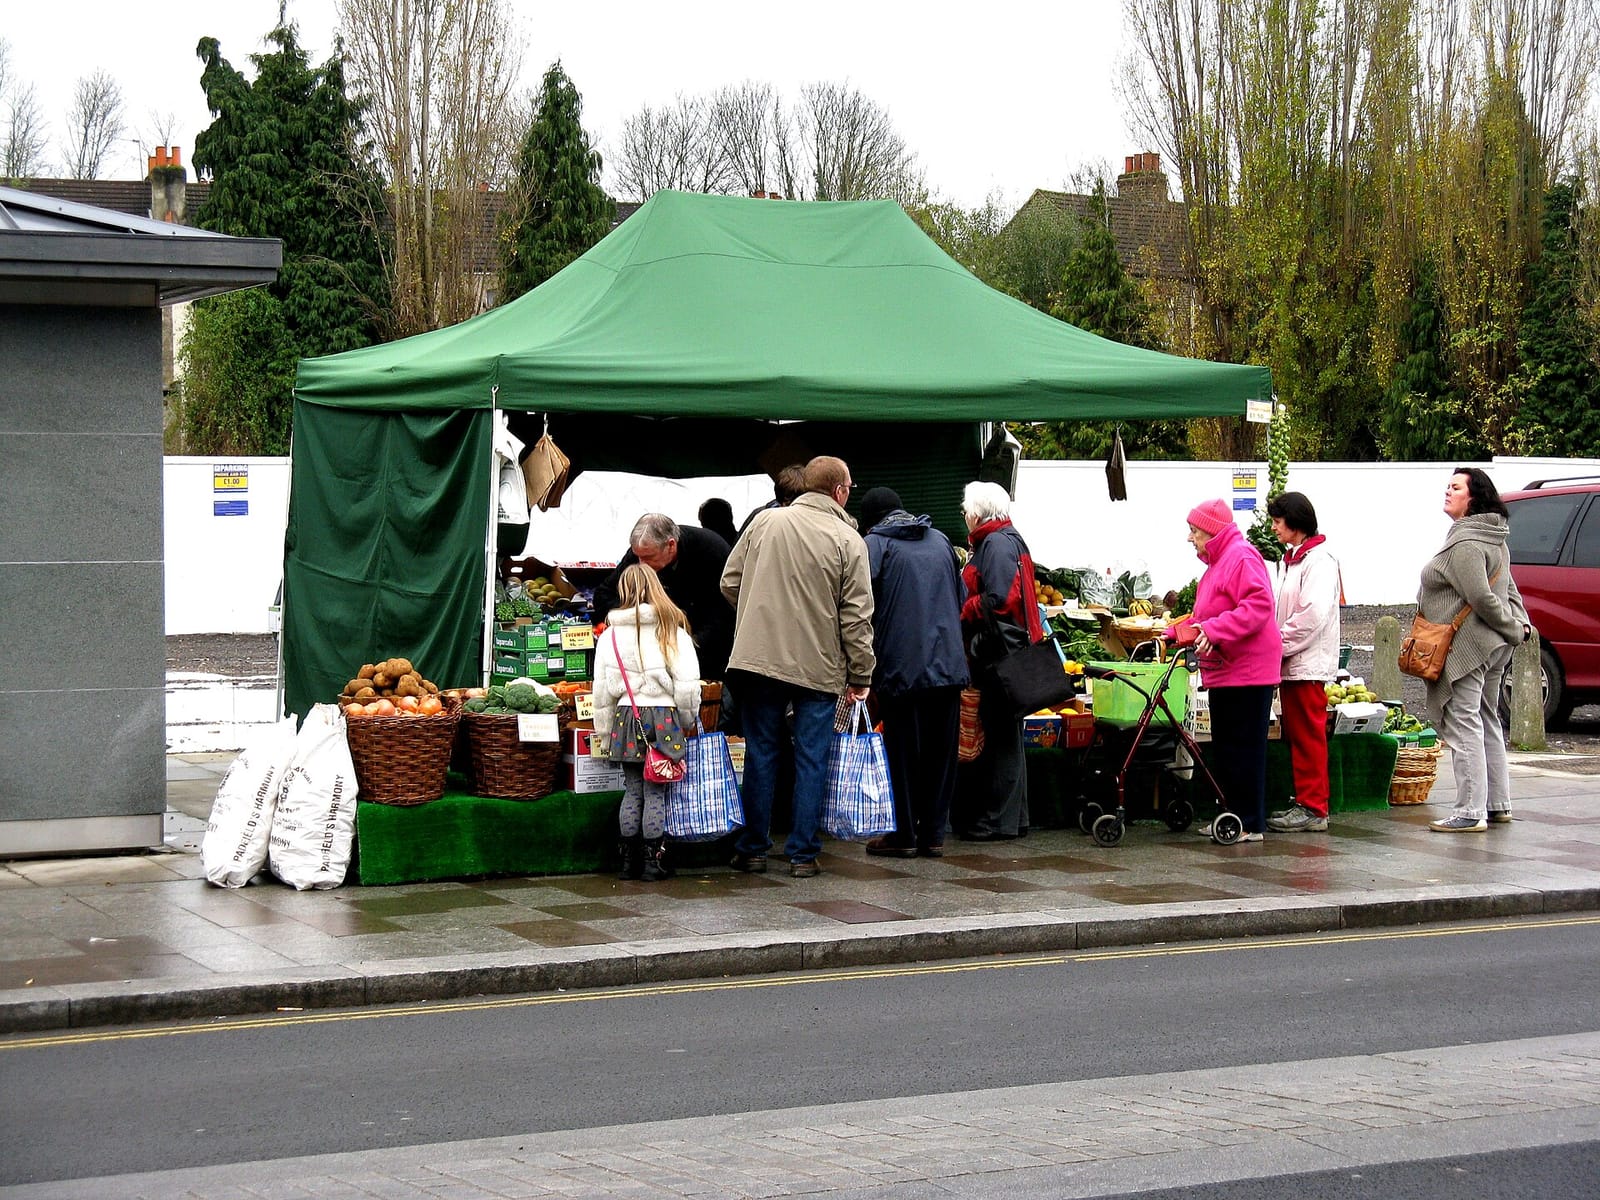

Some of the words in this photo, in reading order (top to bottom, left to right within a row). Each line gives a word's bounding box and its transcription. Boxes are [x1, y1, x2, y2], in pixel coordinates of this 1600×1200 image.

[233, 811, 261, 863] PADFIELD'S
[254, 765, 275, 811] HARMONY
[321, 823, 336, 872] PADFIELD'S
[329, 774, 345, 821] HARMONY
